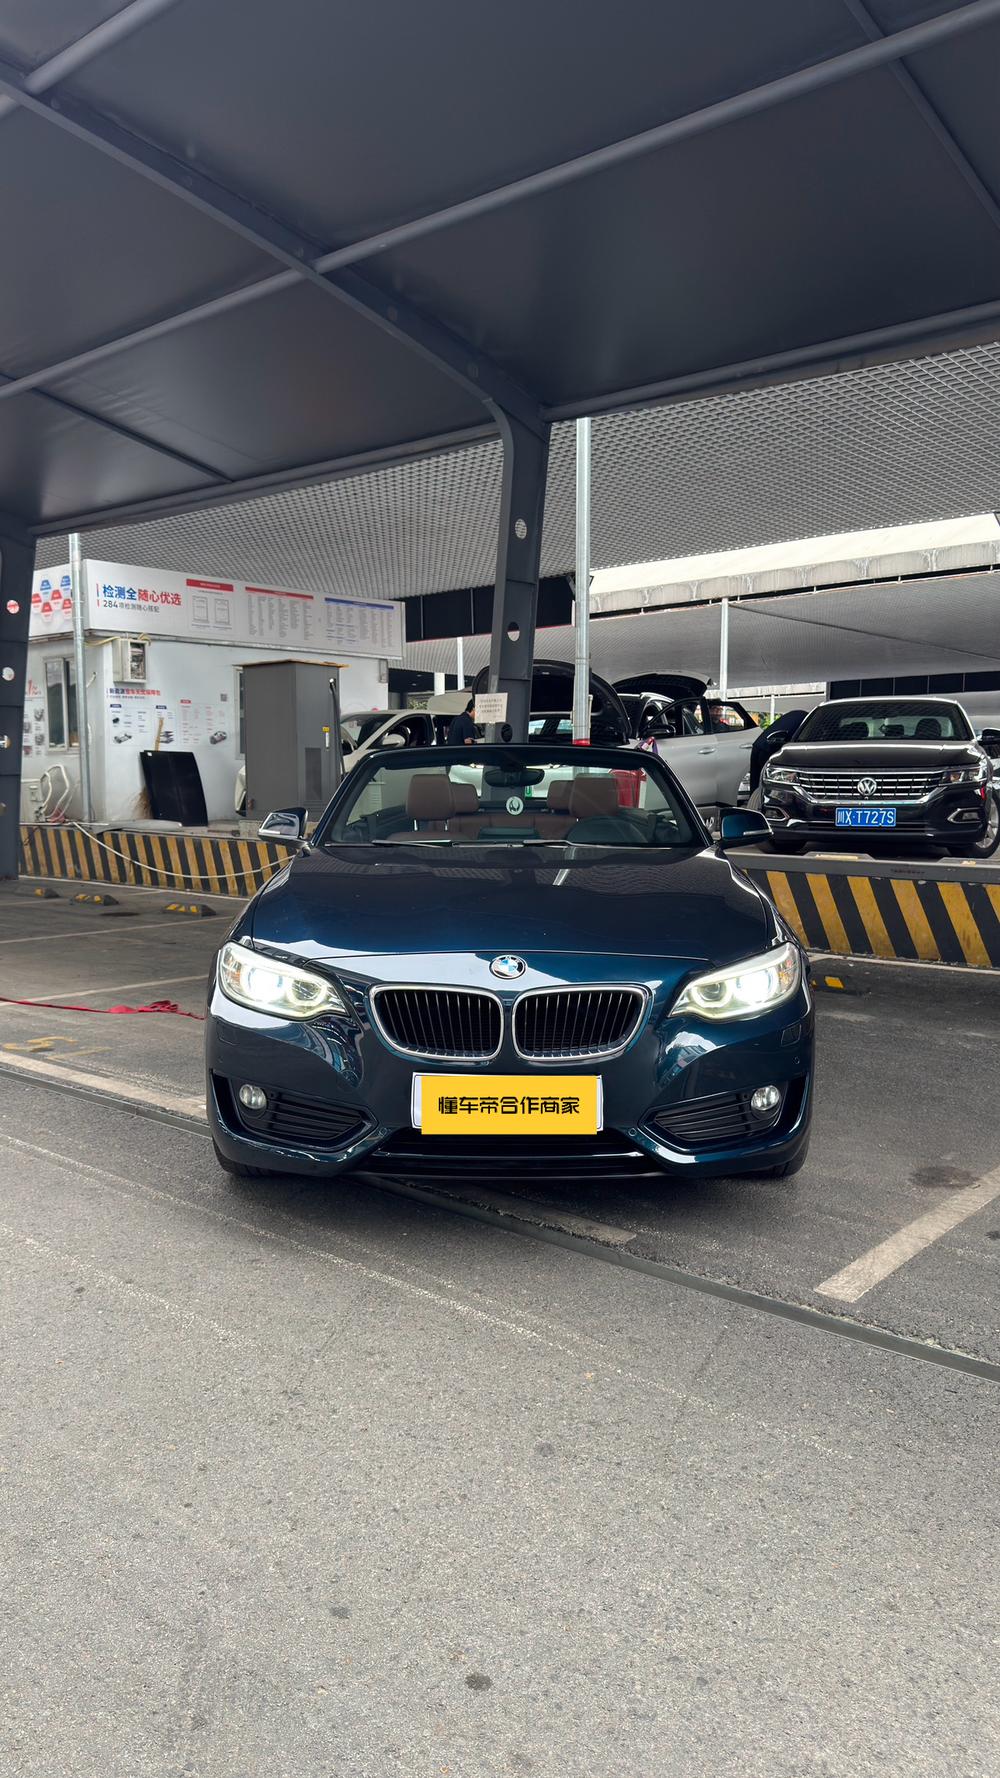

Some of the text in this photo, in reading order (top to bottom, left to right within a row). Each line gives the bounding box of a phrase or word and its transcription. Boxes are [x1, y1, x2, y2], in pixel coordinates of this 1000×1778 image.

[102, 584, 182, 606] 检测全随心优选
